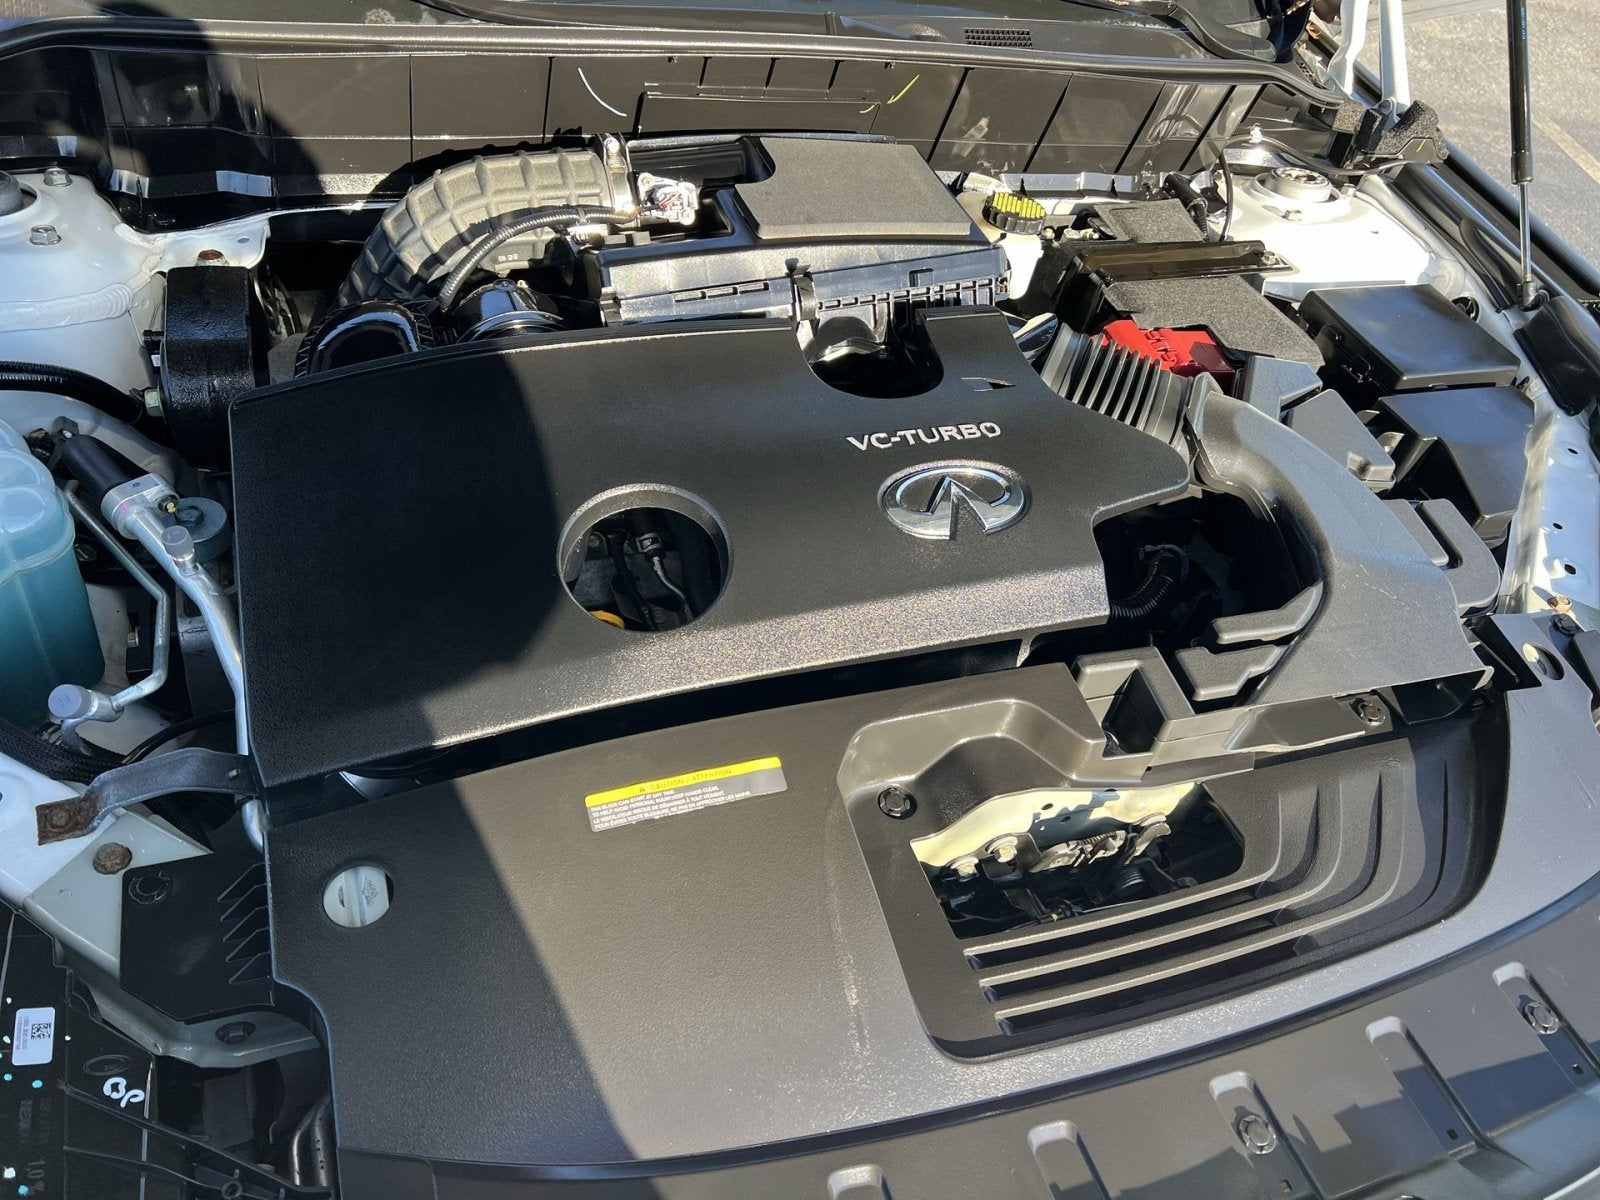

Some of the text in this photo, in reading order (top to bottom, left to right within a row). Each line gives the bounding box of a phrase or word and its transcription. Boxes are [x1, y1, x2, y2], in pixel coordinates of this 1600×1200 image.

[846, 422, 1002, 451] VC-TURBO
[650, 779, 684, 789] CAUTION
[691, 769, 731, 781] ATTENTION
[613, 805, 629, 813] AVOID
[629, 799, 656, 809] PERSONAL
[629, 796, 646, 804] START
[690, 795, 703, 803] TOUT
